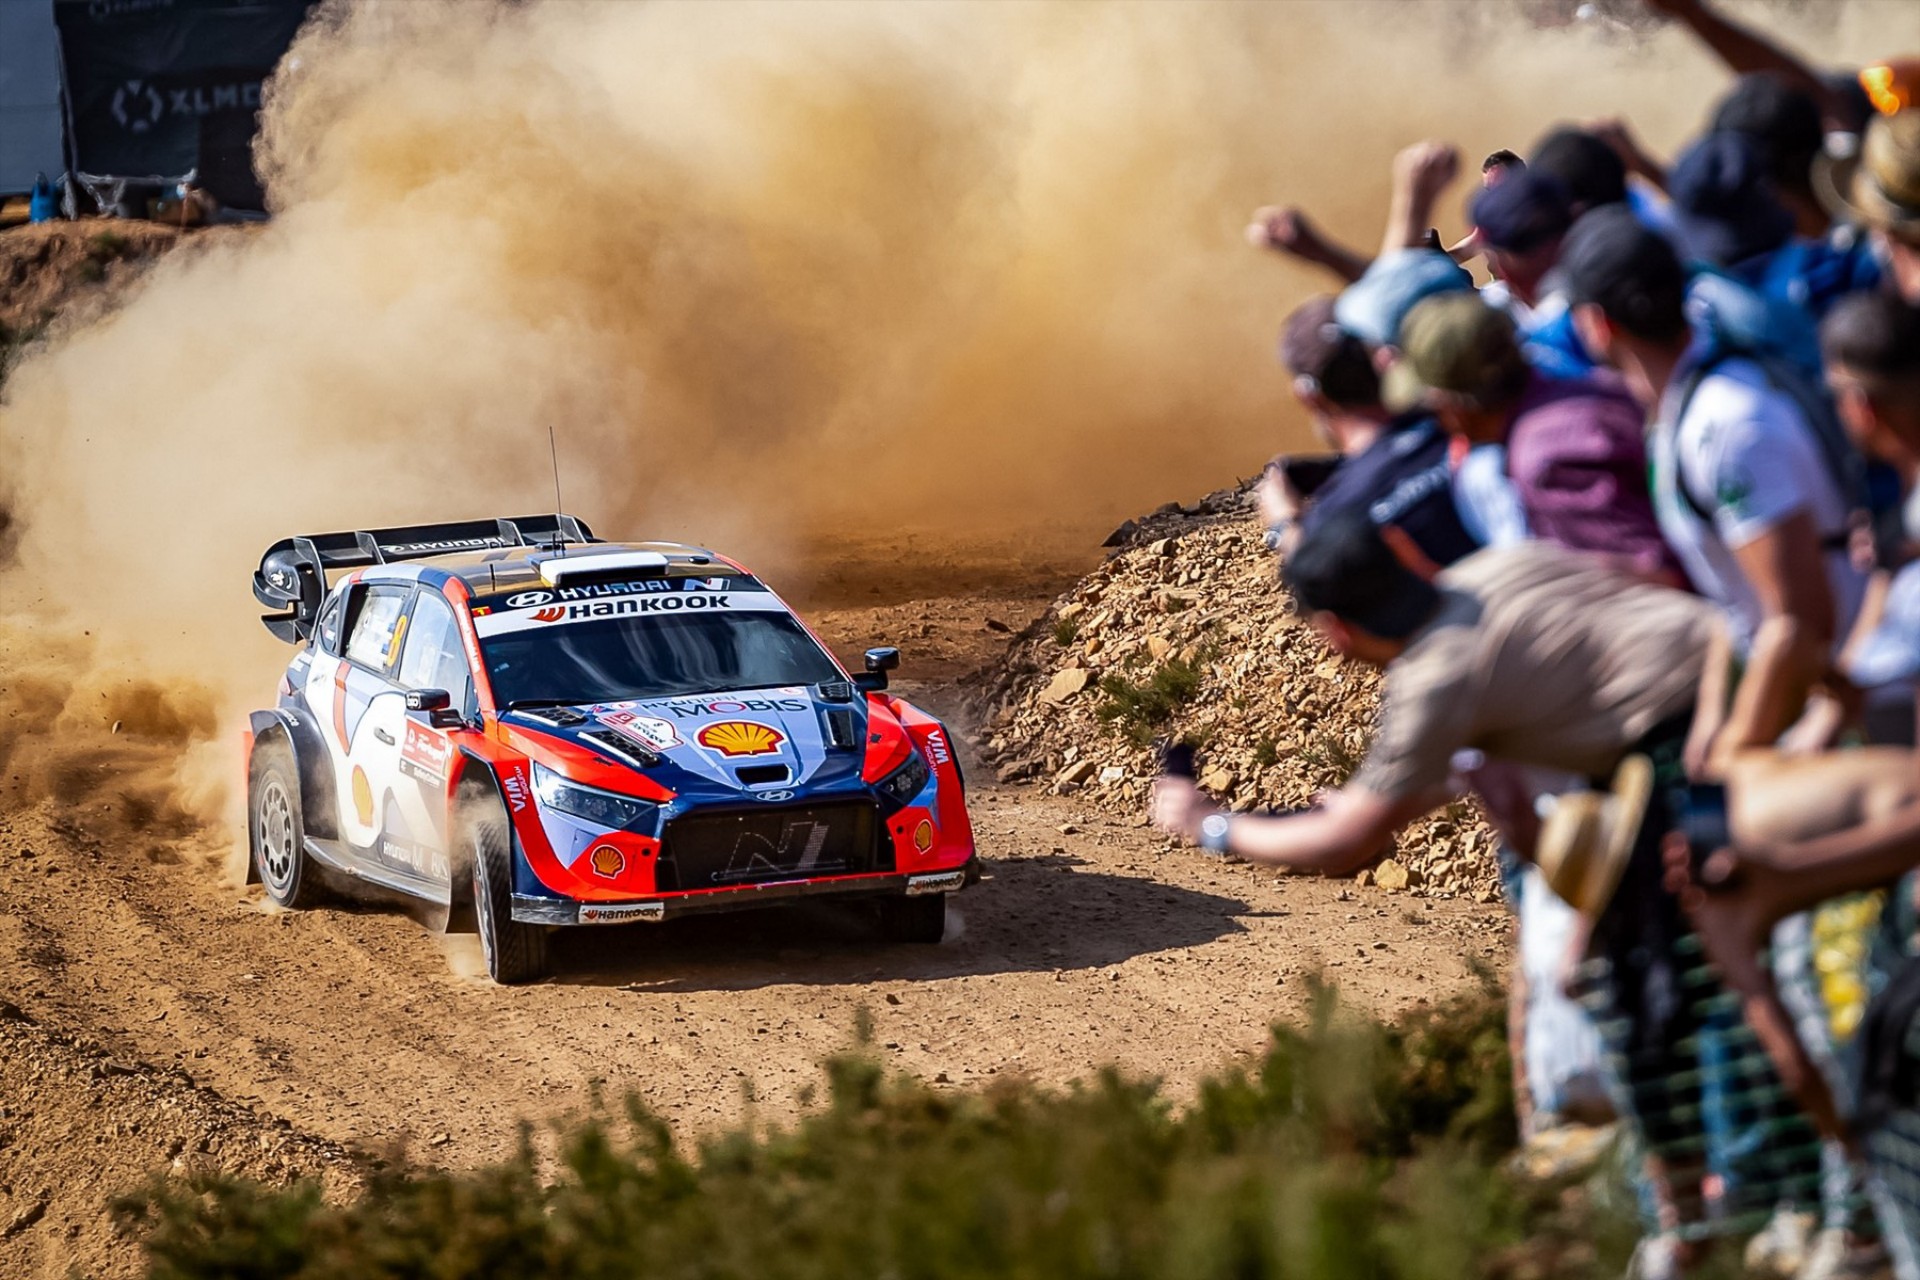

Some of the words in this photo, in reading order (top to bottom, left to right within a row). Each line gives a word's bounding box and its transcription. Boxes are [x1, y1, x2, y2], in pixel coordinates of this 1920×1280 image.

[559, 580, 671, 600] HYUNDAI
[641, 695, 738, 710] HYUNDAI
[668, 698, 808, 718] MOBIS
